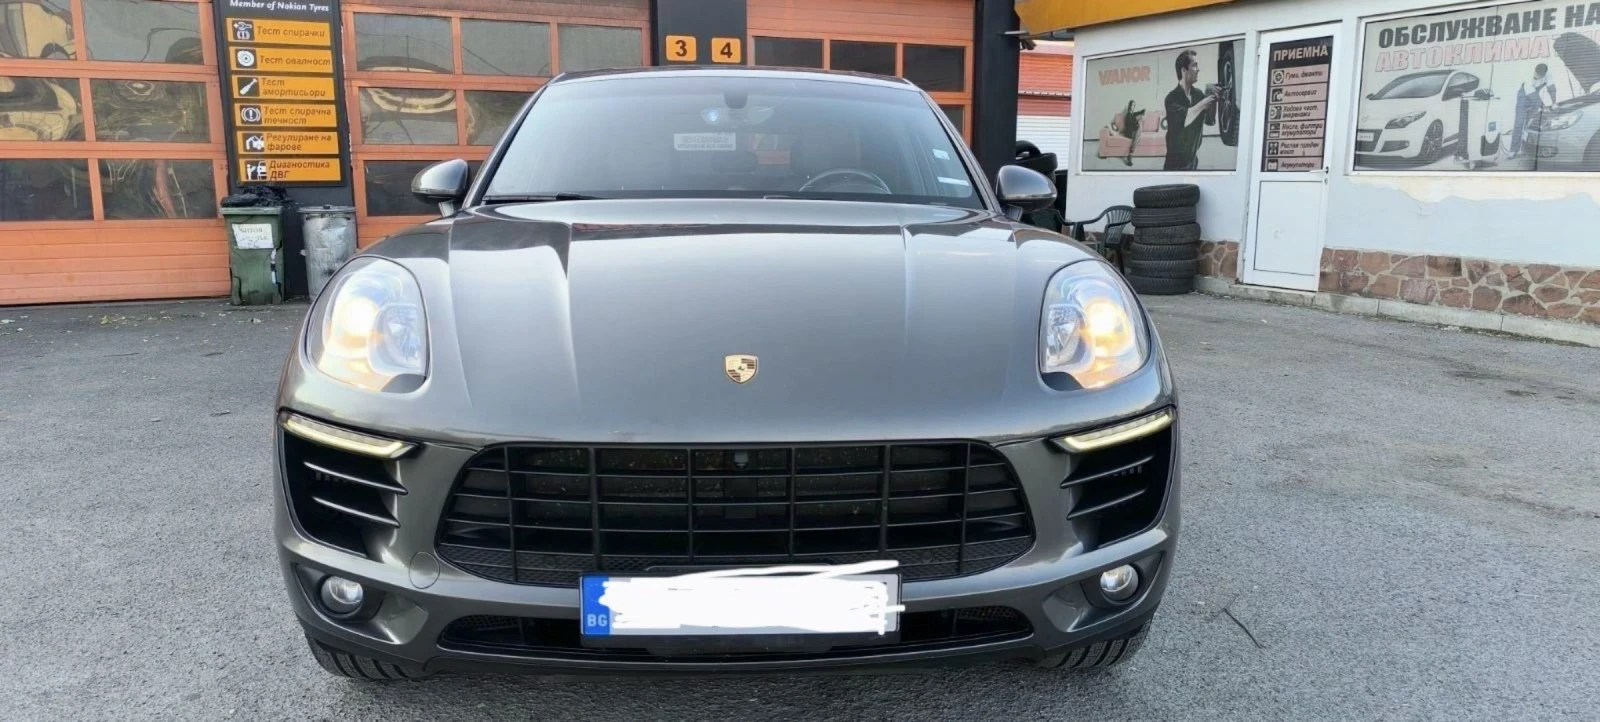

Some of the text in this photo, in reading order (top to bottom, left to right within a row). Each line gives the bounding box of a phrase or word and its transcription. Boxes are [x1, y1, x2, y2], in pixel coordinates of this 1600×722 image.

[229, 0, 330, 12] Member of Nokian Tyres
[1378, 2, 1600, 49] ОБСЛУЖВАНЕ НА
[257, 26, 325, 38] Тест спирачки
[675, 39, 688, 57] 3
[720, 41, 733, 59] 4
[1273, 44, 1329, 62] ПРИЕМНА
[260, 55, 331, 66] Тест овалност
[262, 77, 285, 86] Тест
[262, 87, 326, 97] амортисьори
[264, 106, 331, 118] Тест спирачна
[266, 133, 318, 142] Регулиране
[267, 143, 302, 152] фарове
[269, 160, 330, 169] Диагностика
[270, 170, 290, 180] ДВГ
[587, 614, 607, 627] BG
